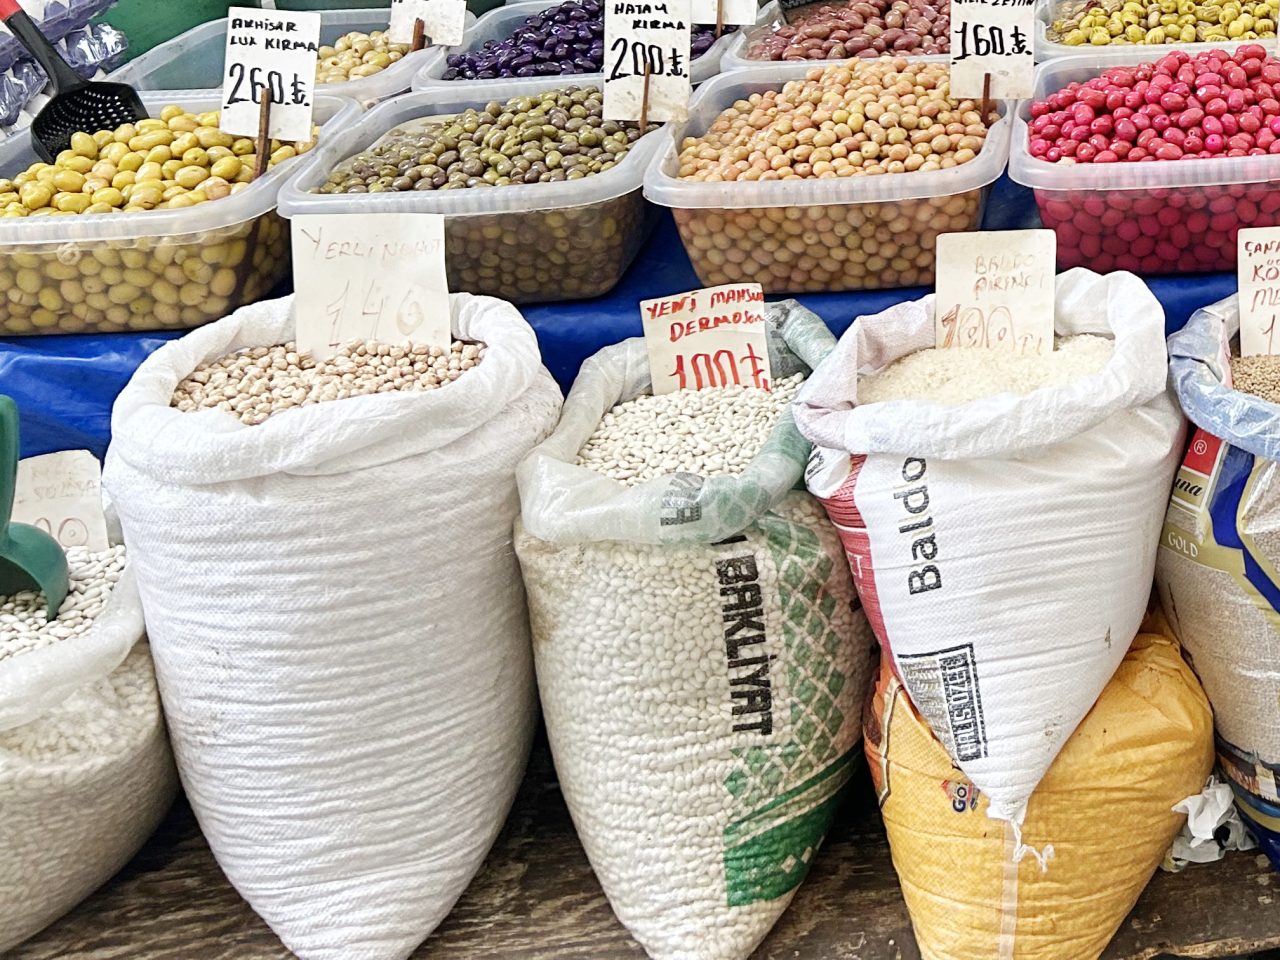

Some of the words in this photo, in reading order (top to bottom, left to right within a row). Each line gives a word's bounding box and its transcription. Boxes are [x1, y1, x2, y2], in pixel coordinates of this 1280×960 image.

[614, 3, 668, 14] HATAY
[232, 18, 298, 32] AKHİSAR
[632, 19, 686, 30] KIRMA
[265, 38, 319, 52] KIRMA
[894, 457, 942, 595] Baldo
[1168, 532, 1198, 557] GOLD
[715, 554, 777, 736] BAKLİYAT
